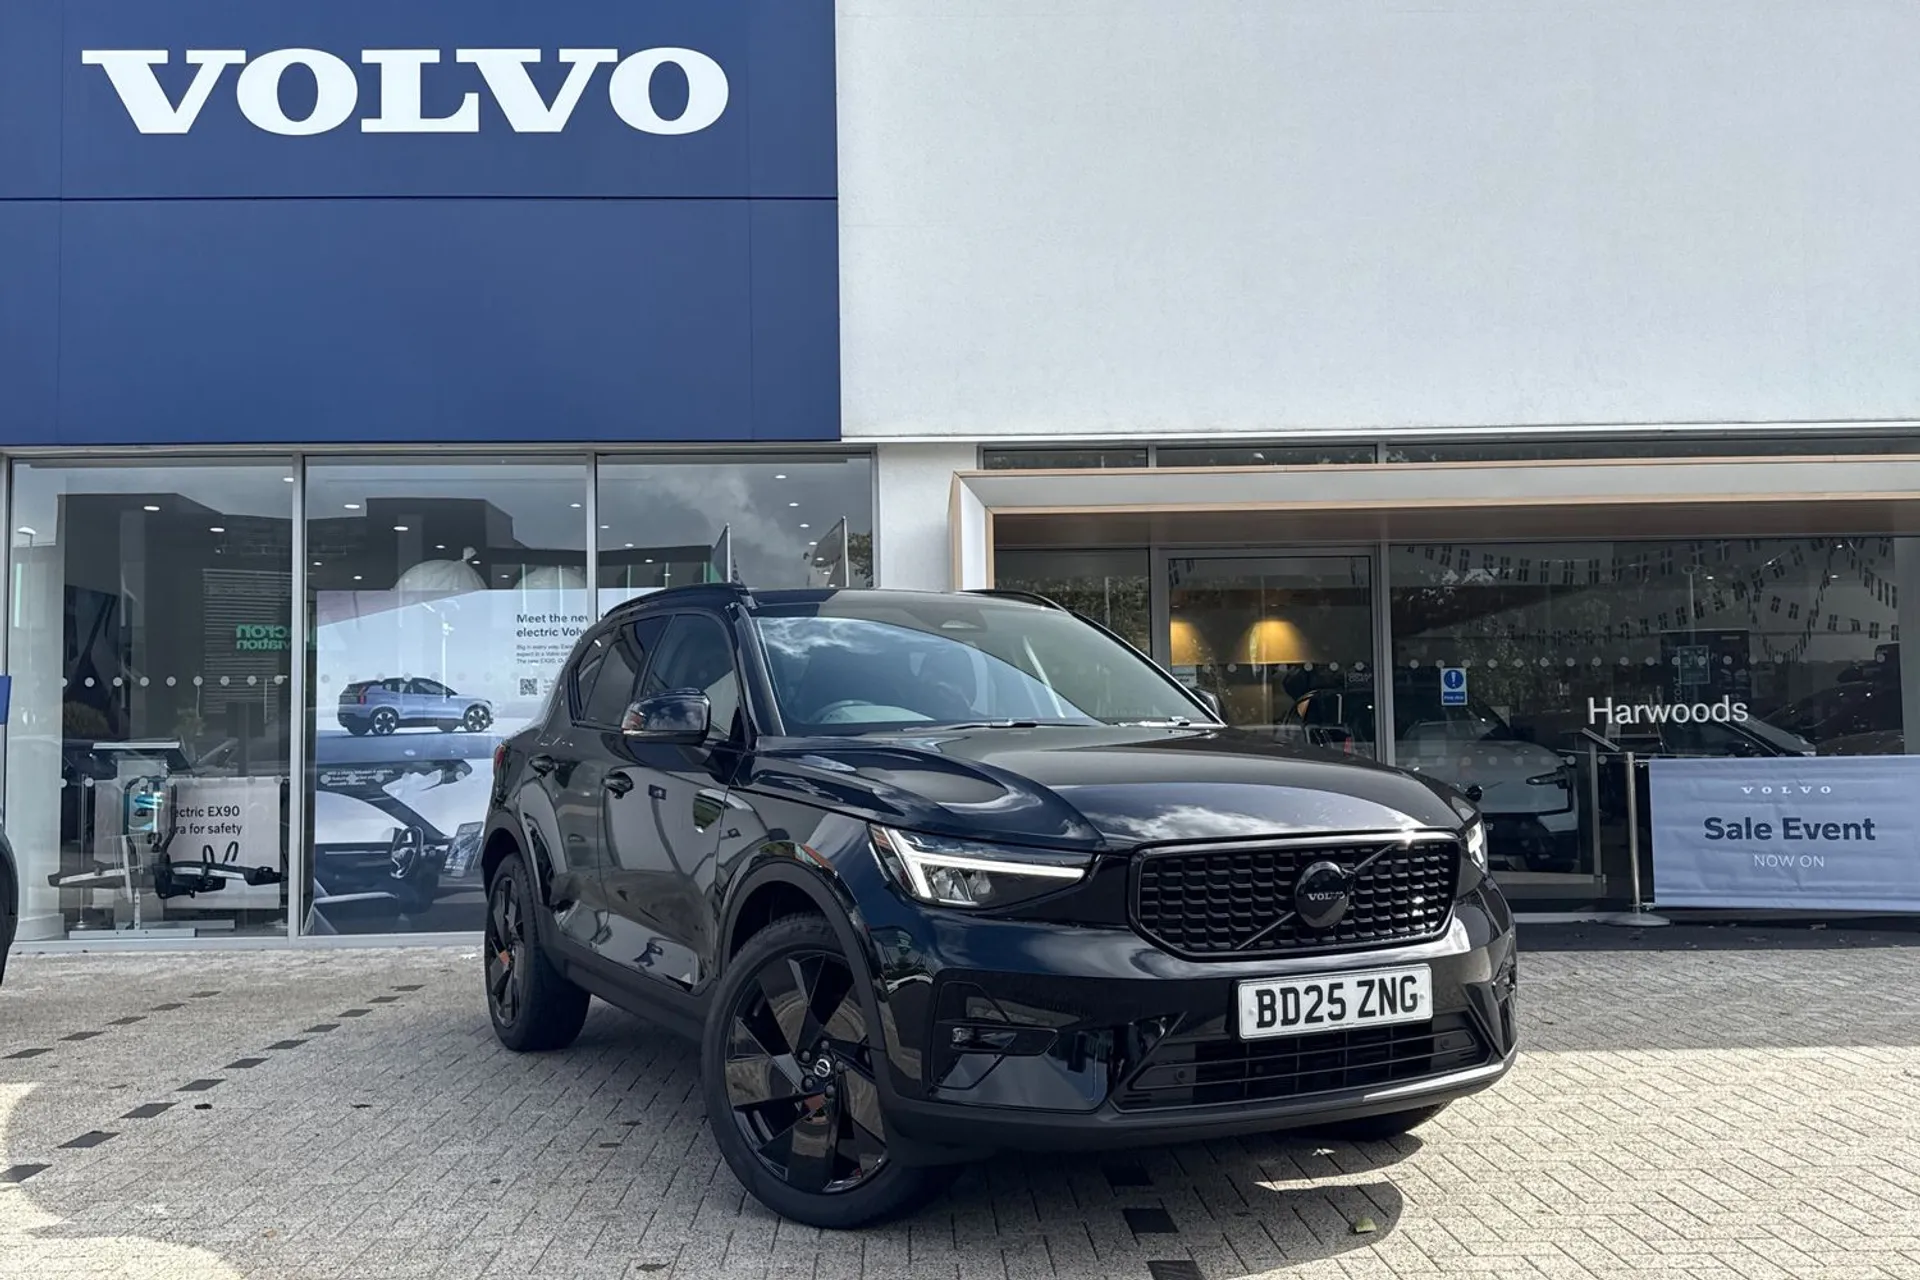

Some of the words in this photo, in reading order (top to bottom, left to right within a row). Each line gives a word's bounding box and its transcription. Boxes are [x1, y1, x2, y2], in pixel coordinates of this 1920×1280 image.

[82, 47, 729, 135] VOLVO
[516, 614, 546, 623] Meet
[549, 614, 568, 623] the
[516, 627, 559, 637] electric
[562, 627, 586, 637] Volv
[1587, 694, 1749, 724] Harwoods
[1741, 785, 1832, 794] VOLVO
[175, 805, 204, 818] ectric
[207, 805, 241, 818] EX90
[189, 823, 205, 835] for
[207, 822, 243, 837] safety
[1704, 816, 1773, 841] Sale
[1782, 817, 1876, 841] Event
[1754, 854, 1796, 868] NOW
[1800, 855, 1824, 868] ON
[1307, 890, 1346, 901] VOLVO
[1255, 982, 1347, 1029] BD25
[1356, 975, 1419, 1018] ZNG
